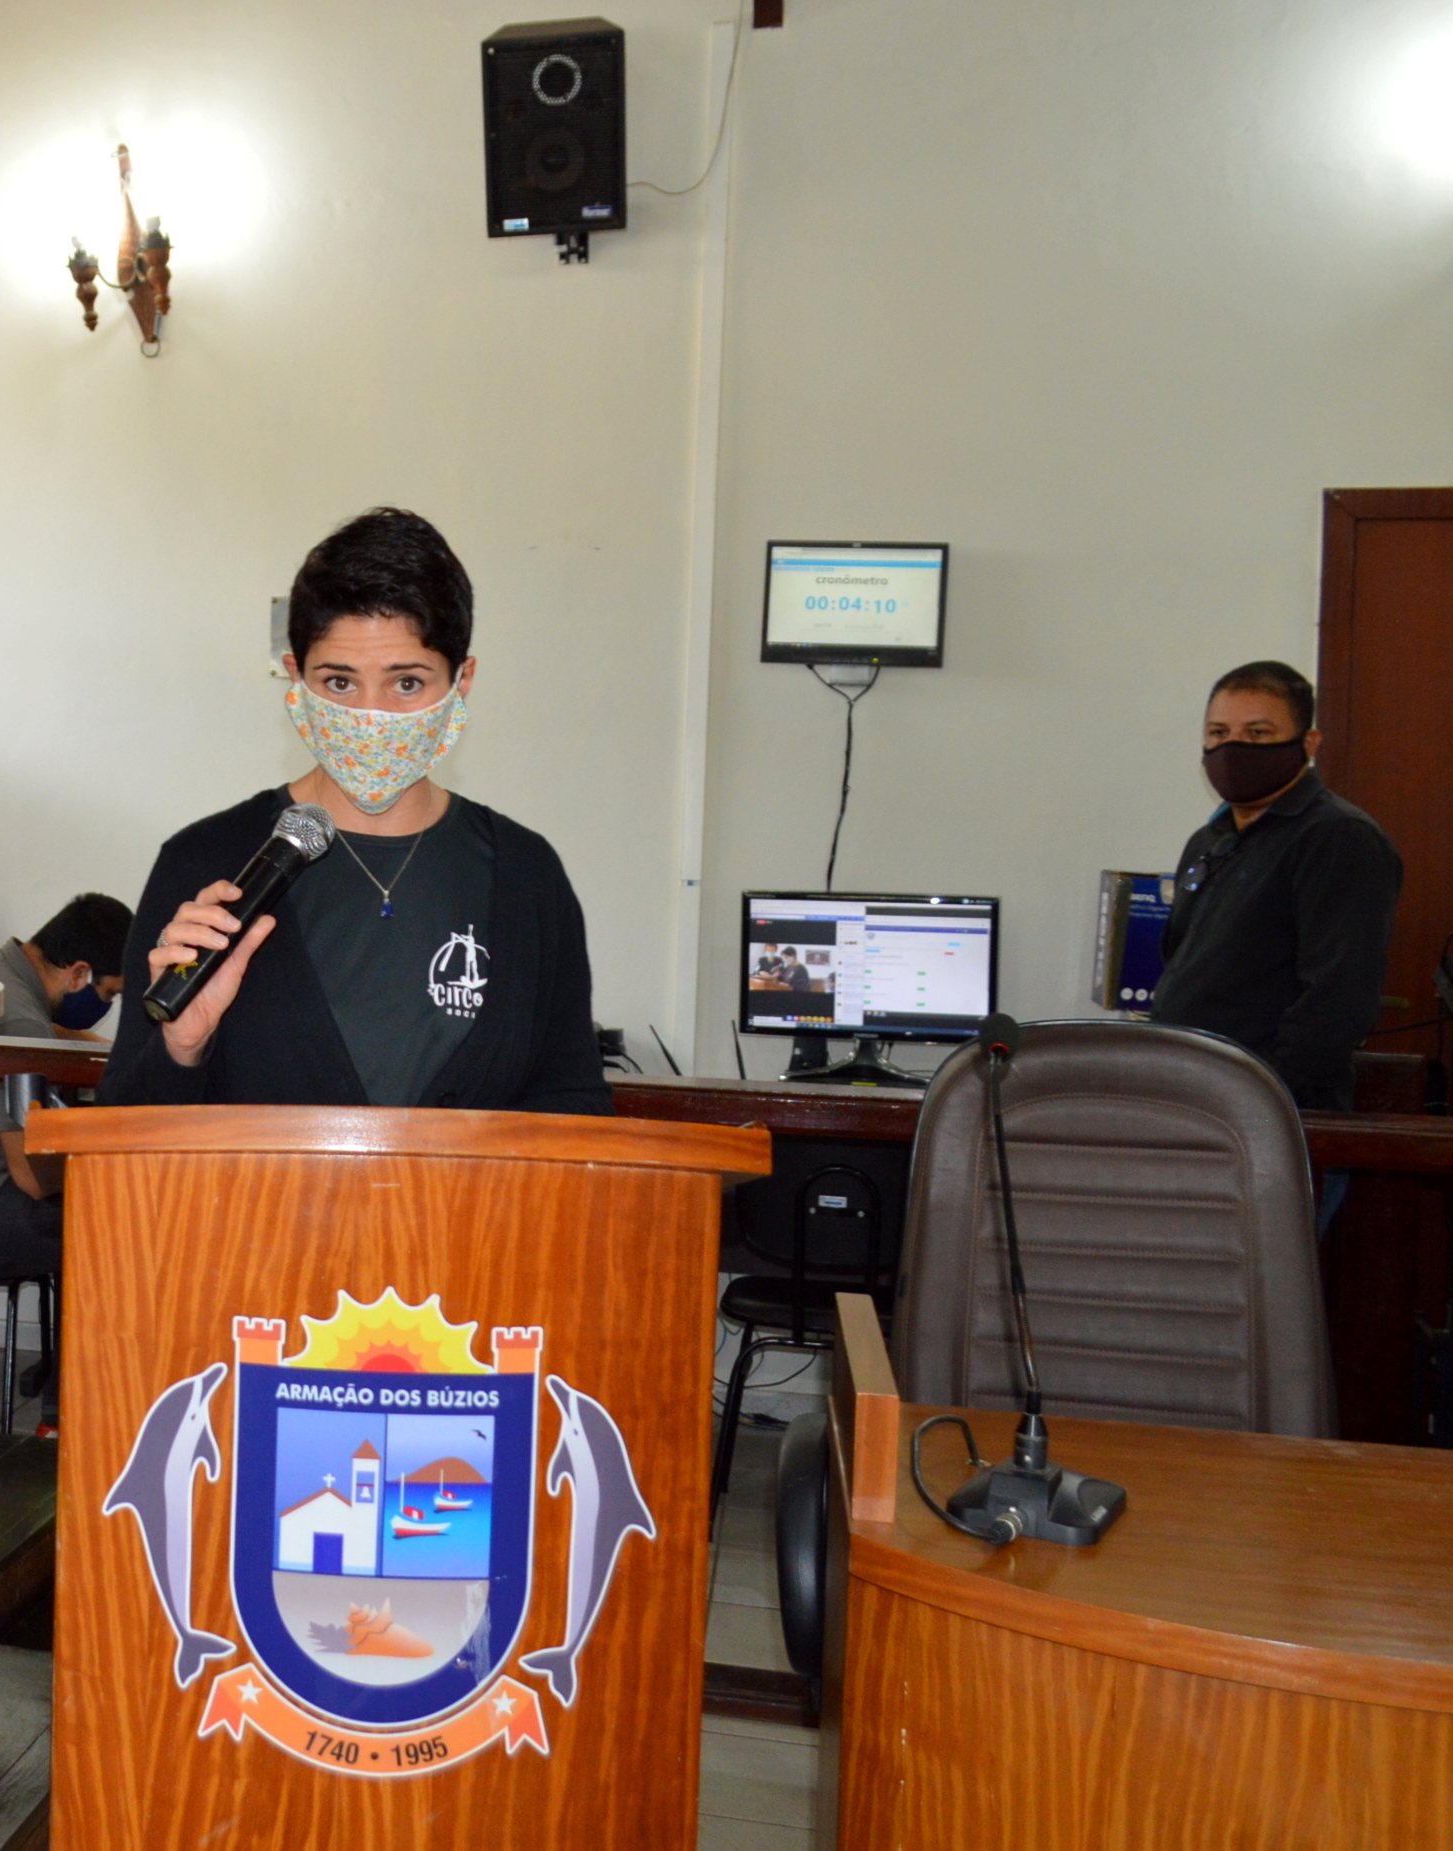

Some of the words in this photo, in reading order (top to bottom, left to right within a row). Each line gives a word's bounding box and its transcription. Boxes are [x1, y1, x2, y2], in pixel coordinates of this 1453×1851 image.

[805, 595, 898, 614] 00:04:10
[275, 1382, 375, 1408] ARMAÇÃO
[379, 1388, 422, 1406] DOS
[426, 1385, 500, 1408] BÚZIOS
[304, 1730, 360, 1765] 1740
[390, 1735, 449, 1767] 1995
